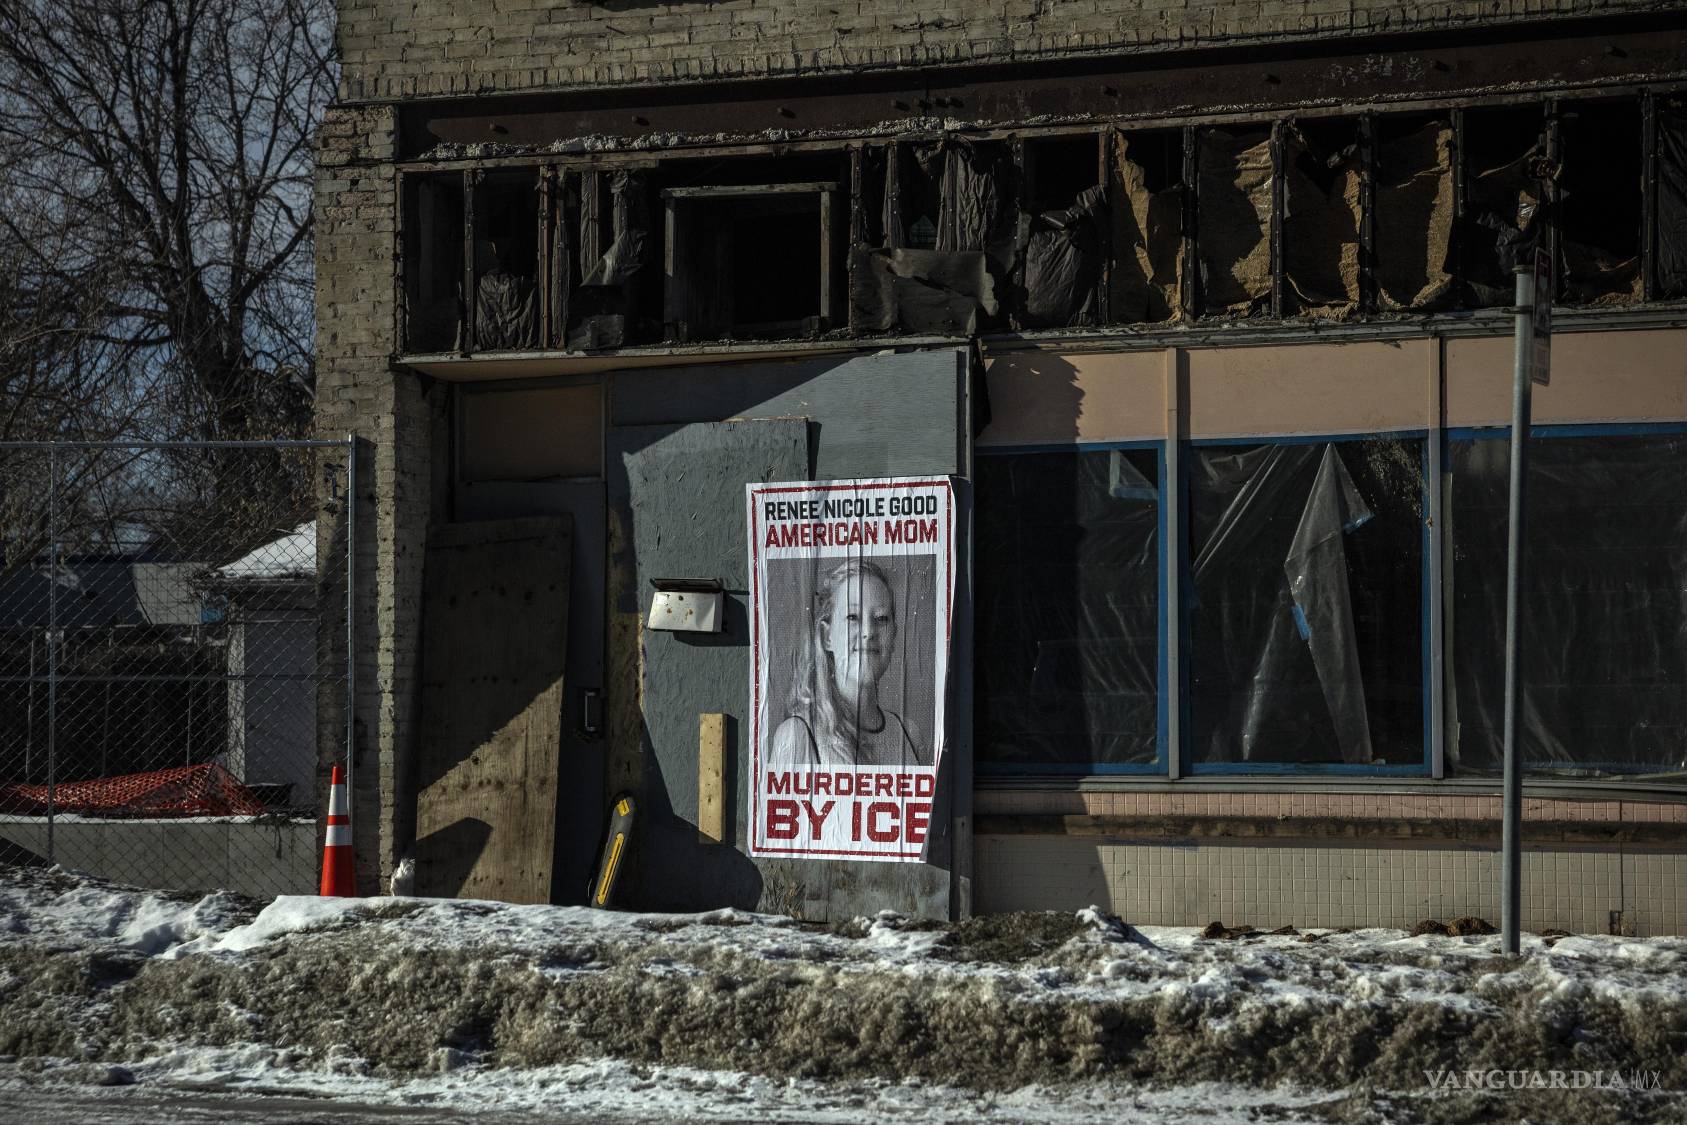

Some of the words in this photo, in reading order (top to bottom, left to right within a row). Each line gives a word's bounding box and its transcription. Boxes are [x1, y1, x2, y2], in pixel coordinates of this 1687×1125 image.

[765, 501, 819, 520] RENEE
[825, 498, 884, 518] NICOLE
[890, 495, 937, 515] GOOD
[765, 521, 878, 547] AMERICAN
[885, 518, 937, 544] MOM
[767, 771, 935, 797] MURDERED
[767, 799, 836, 841] BY
[852, 801, 932, 843] ICE
